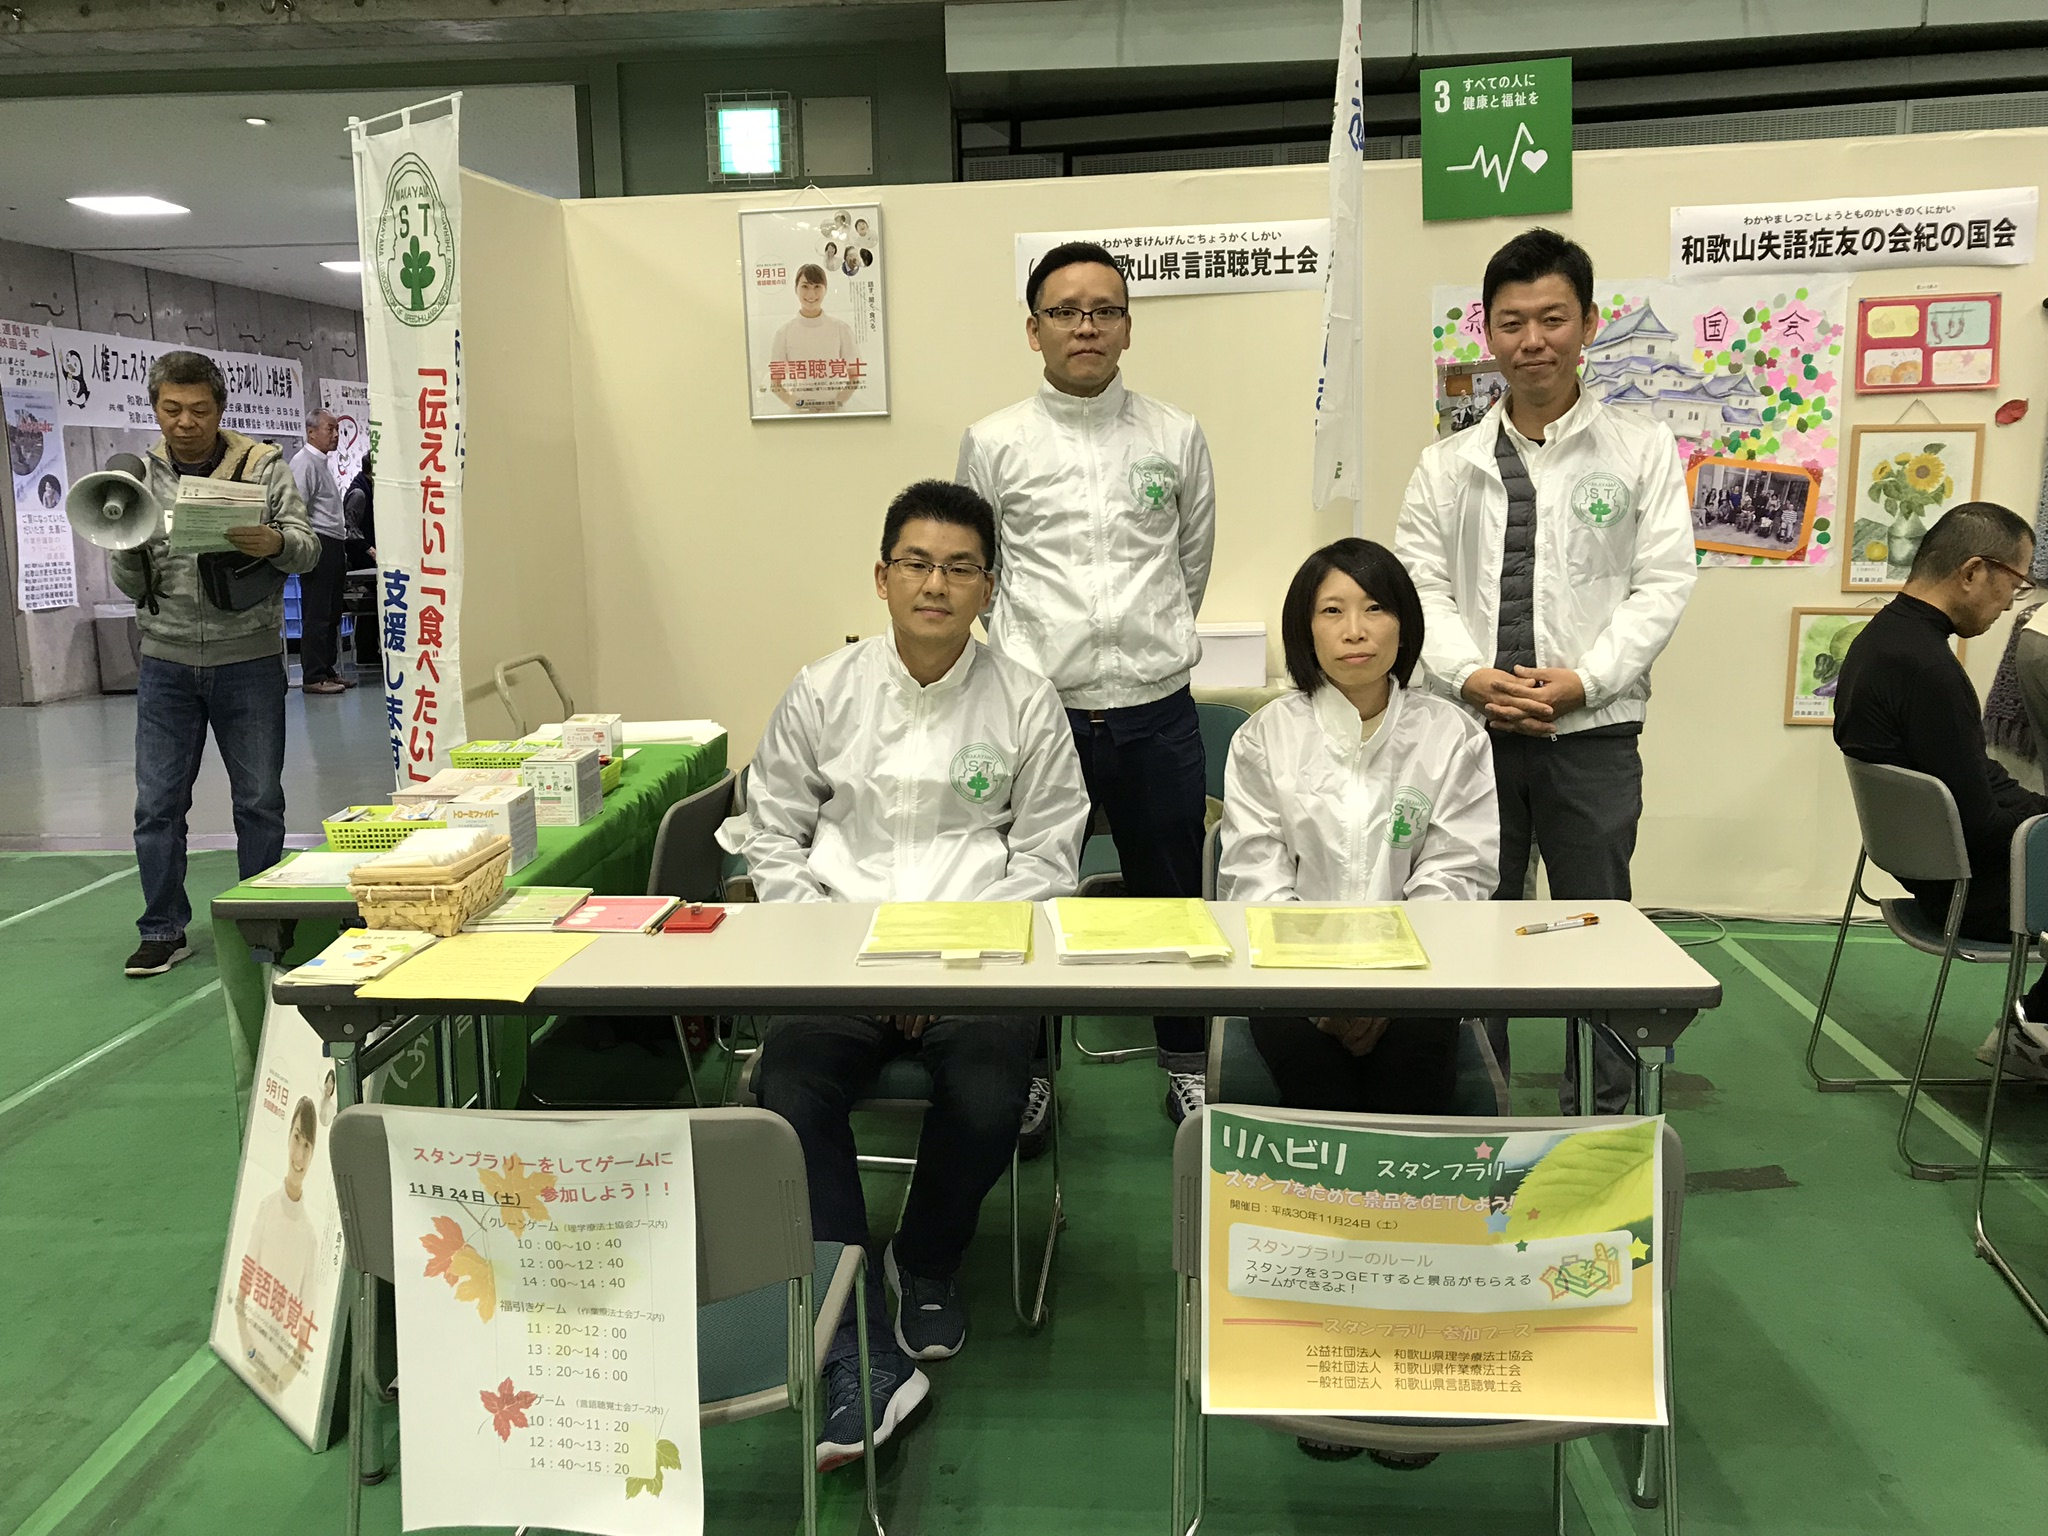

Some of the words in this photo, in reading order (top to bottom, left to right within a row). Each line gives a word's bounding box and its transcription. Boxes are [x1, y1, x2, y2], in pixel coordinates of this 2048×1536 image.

[1463, 74, 1535, 92] すべての人に
[1434, 80, 1451, 113] 3
[1463, 91, 1539, 110] 健康と福祉を
[1744, 205, 1956, 226] わかやましつごしょうとものかいきのくにかい
[1681, 218, 2018, 265] 和歌山失語症友の会紀の国会
[755, 267, 787, 279] 9月1日
[1703, 310, 1728, 342] 国
[1778, 309, 1809, 342] 会
[768, 358, 869, 380] 言語聴覚士
[408, 367, 447, 783] 「伝えたい」「食べたい」
[383, 568, 410, 770] 支援します
[413, 1147, 674, 1174] スタンプラリーをしてゲームに
[1222, 1125, 1348, 1176] リハビリ
[541, 1182, 671, 1204] 参加しよう！！
[489, 1217, 559, 1232] クレーンゲーム
[1247, 1236, 1434, 1268] スタンプラリーのルール
[1246, 1273, 1355, 1294] ゲームができるよ！
[239, 1254, 319, 1353] 言語聴覚士
[500, 1300, 567, 1315] 福引きゲーム
[1306, 1344, 1382, 1359] 公益社団法人
[1394, 1348, 1534, 1361] 和歌山県理学療法士協会
[1306, 1360, 1382, 1374] 一般社団法人
[1394, 1362, 1521, 1377] 和歌山県作業療法士会
[1306, 1376, 1382, 1390] 一般社団法人
[1394, 1377, 1522, 1393] 和歌山県言語聴覚士会
